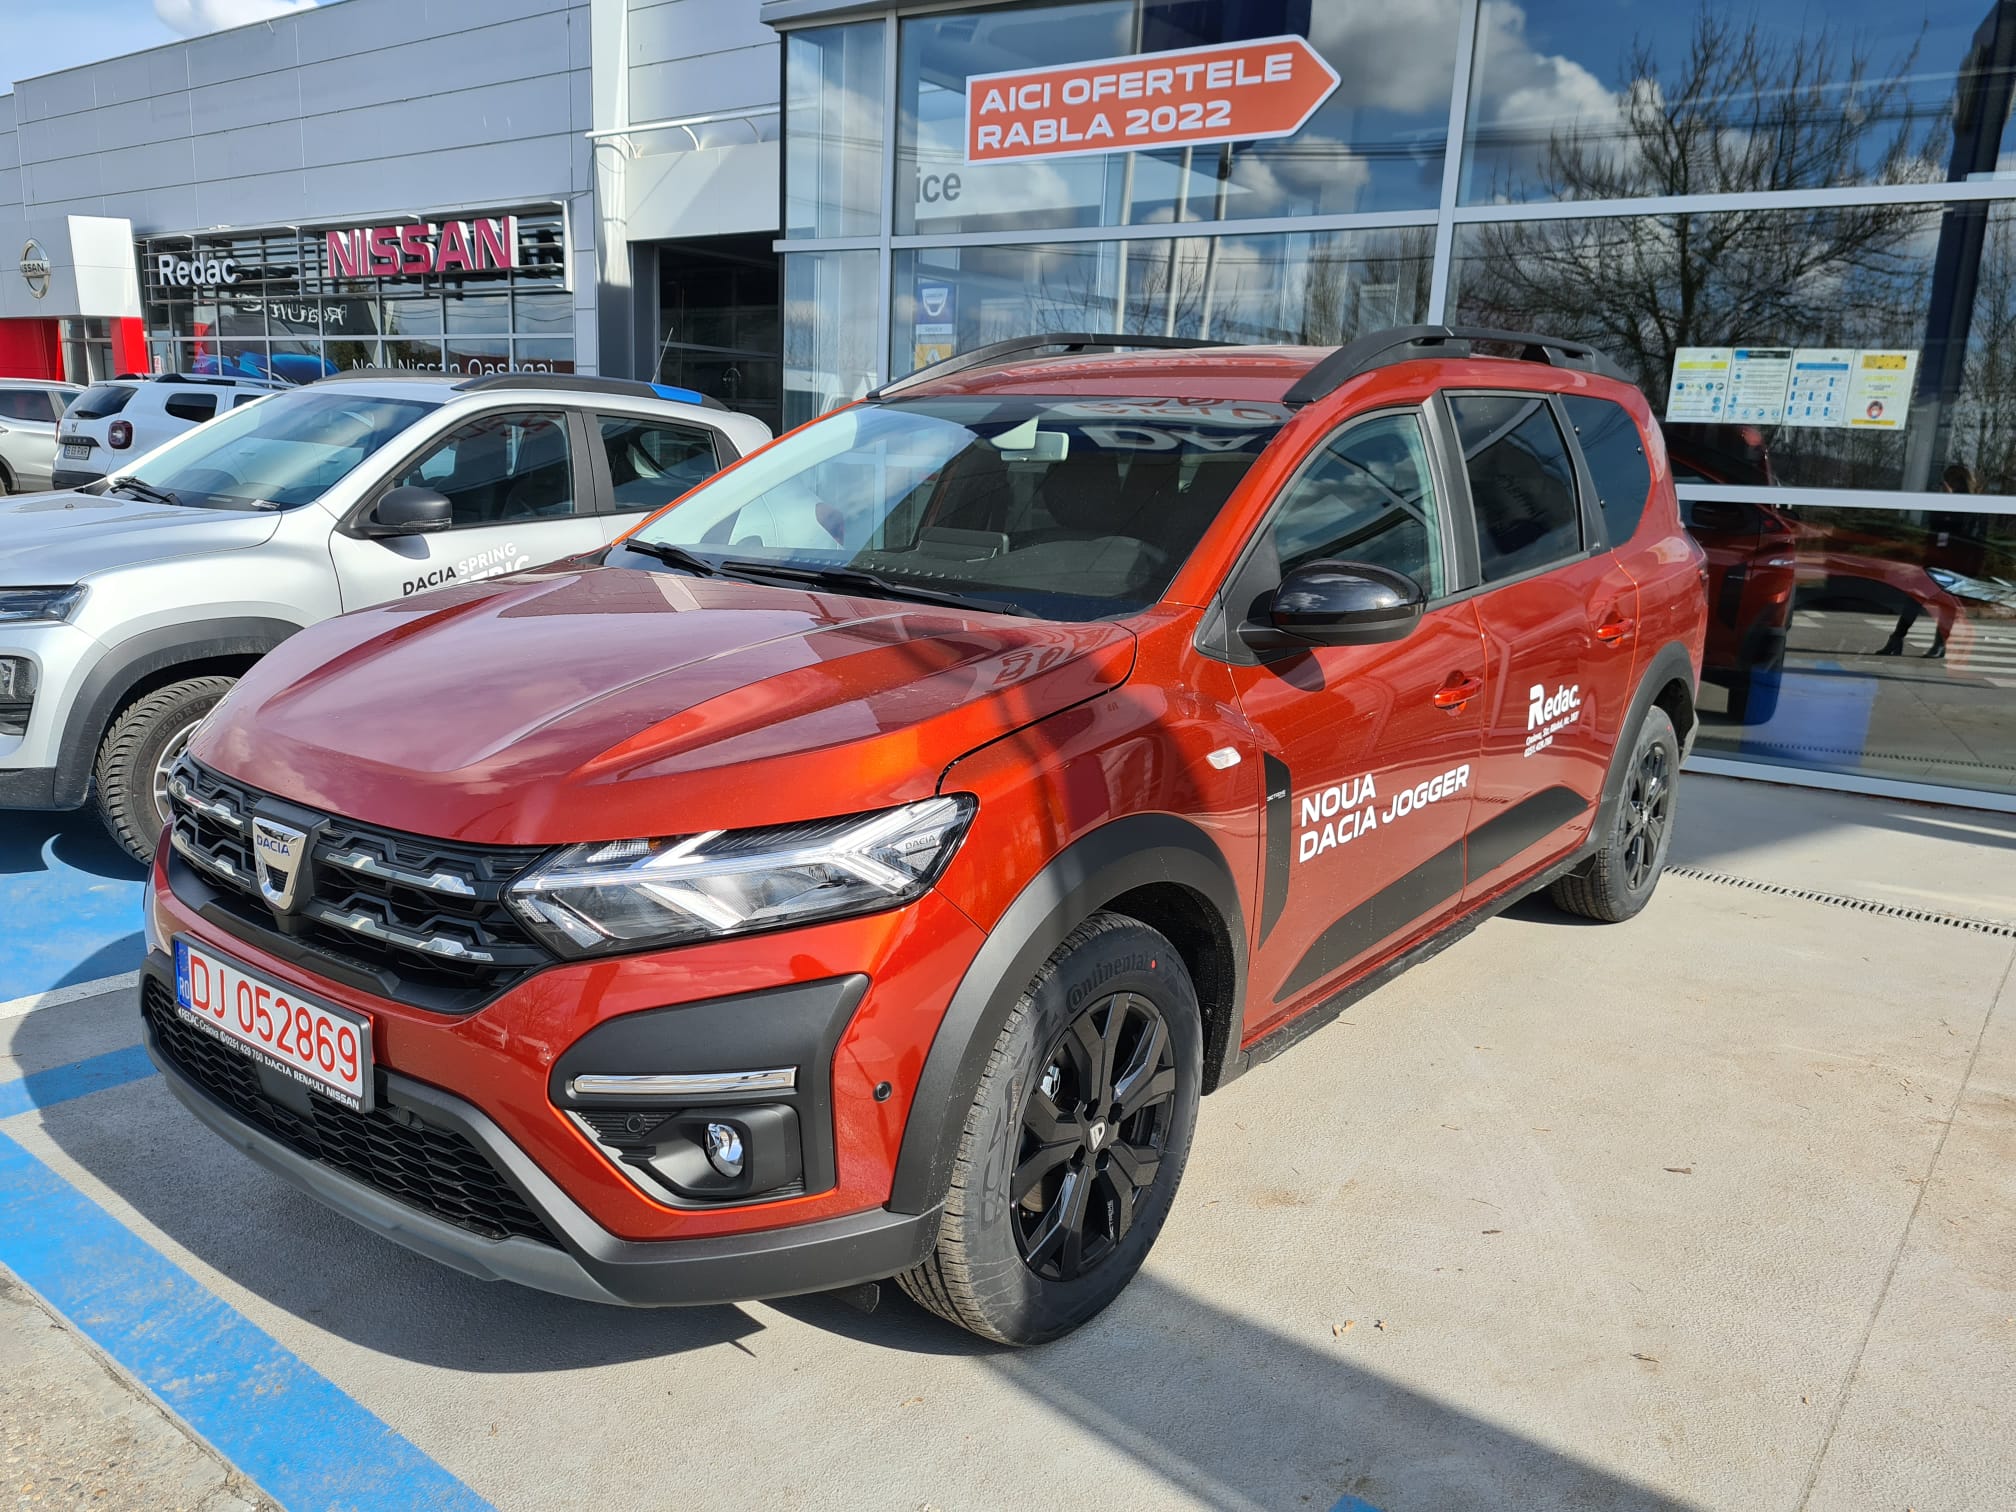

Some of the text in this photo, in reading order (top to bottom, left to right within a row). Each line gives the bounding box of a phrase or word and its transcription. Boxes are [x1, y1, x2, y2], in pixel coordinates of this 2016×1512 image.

[979, 52, 1294, 115] AICI OFERTELE
[976, 100, 1232, 150] RABLA 2022
[915, 168, 962, 204] ice
[158, 253, 238, 286] Redac
[326, 215, 519, 278] NISSAN
[402, 542, 517, 596] DACIA SPRING
[1298, 763, 1470, 864] DACIA JOGGER
[1300, 773, 1377, 828] NOUA
[256, 834, 290, 857] DACIA
[905, 834, 936, 850] DACIA
[1066, 951, 1153, 1014] Continental
[179, 953, 358, 1083] RO DJ 052869
[265, 1055, 292, 1078] DACIA
[293, 1070, 325, 1094] RENAULT
[326, 1086, 360, 1111] NISSAN
